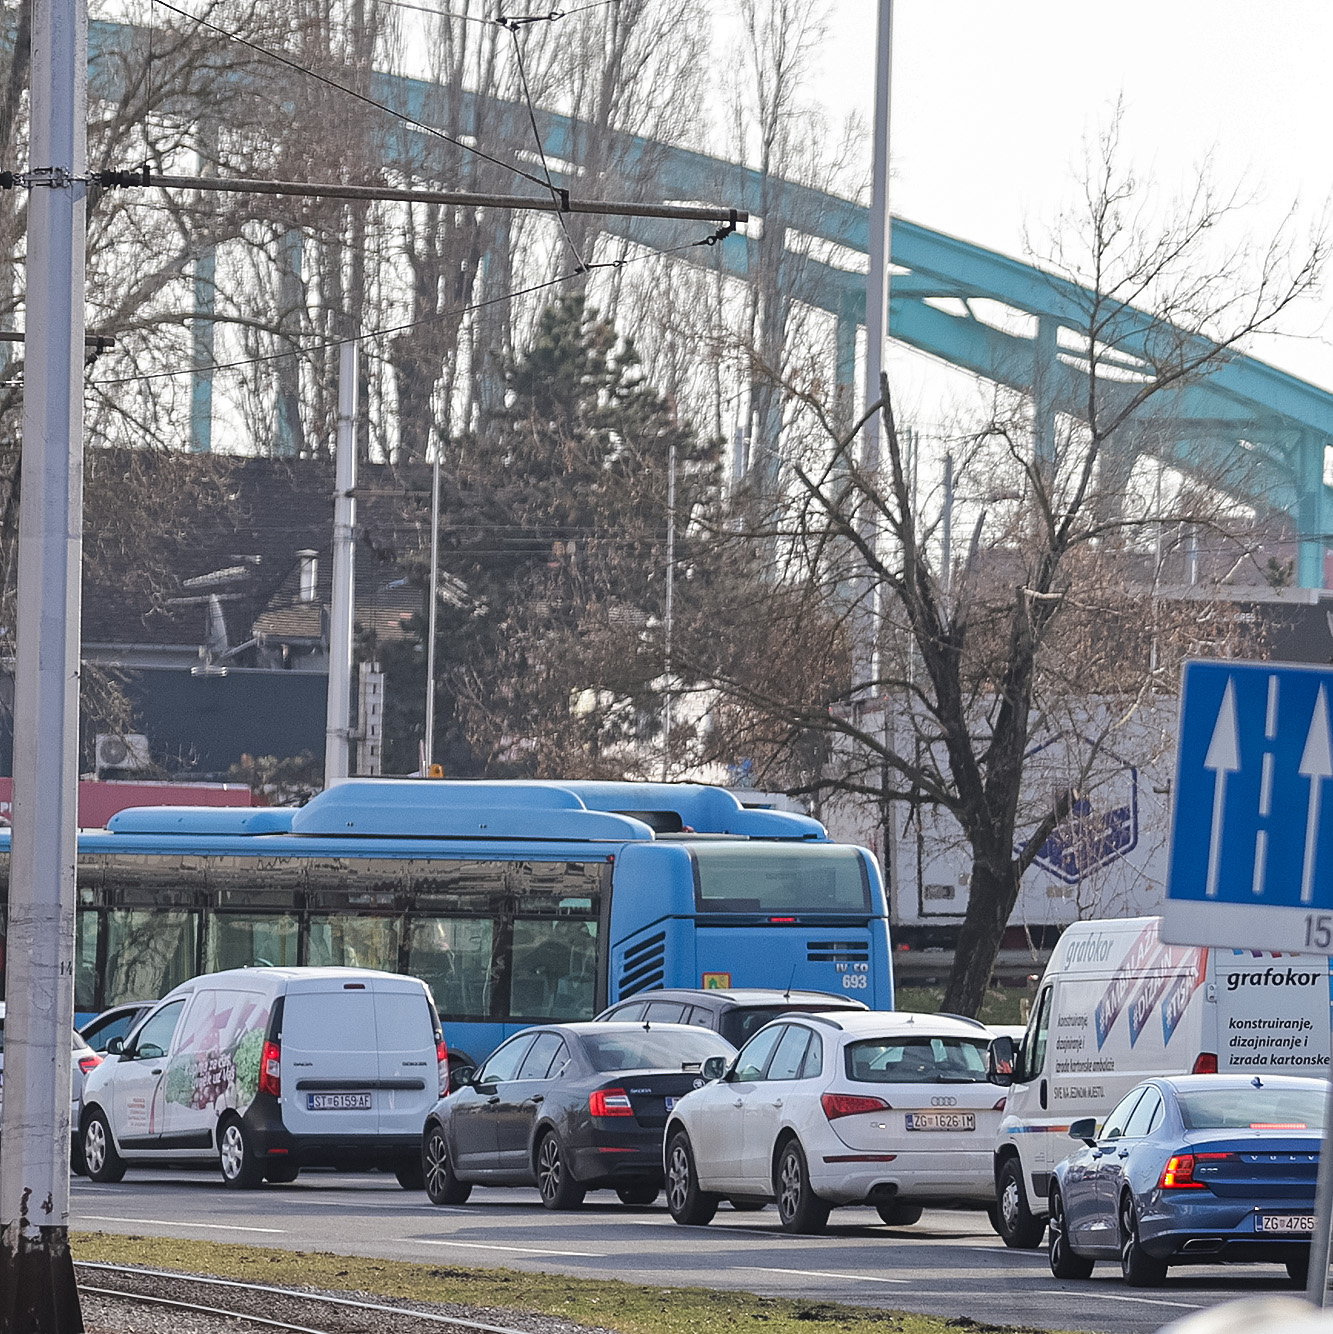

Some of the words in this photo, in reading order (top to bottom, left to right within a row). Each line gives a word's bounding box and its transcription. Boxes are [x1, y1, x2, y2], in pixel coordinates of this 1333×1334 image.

[1065, 932, 1114, 969] grafokor
[842, 974, 867, 989] 693
[1227, 968, 1321, 990] grafokor
[1229, 1017, 1313, 1031] konstruiranje,
[1229, 1035, 1302, 1050] dizajniranje
[1304, 1036, 1309, 1047] i
[1229, 1054, 1268, 1065] izrada
[1270, 1054, 1330, 1065] kartonske
[315, 1094, 327, 1107] ST
[914, 1115, 927, 1127] ZG
[1264, 1217, 1279, 1230] ZG
